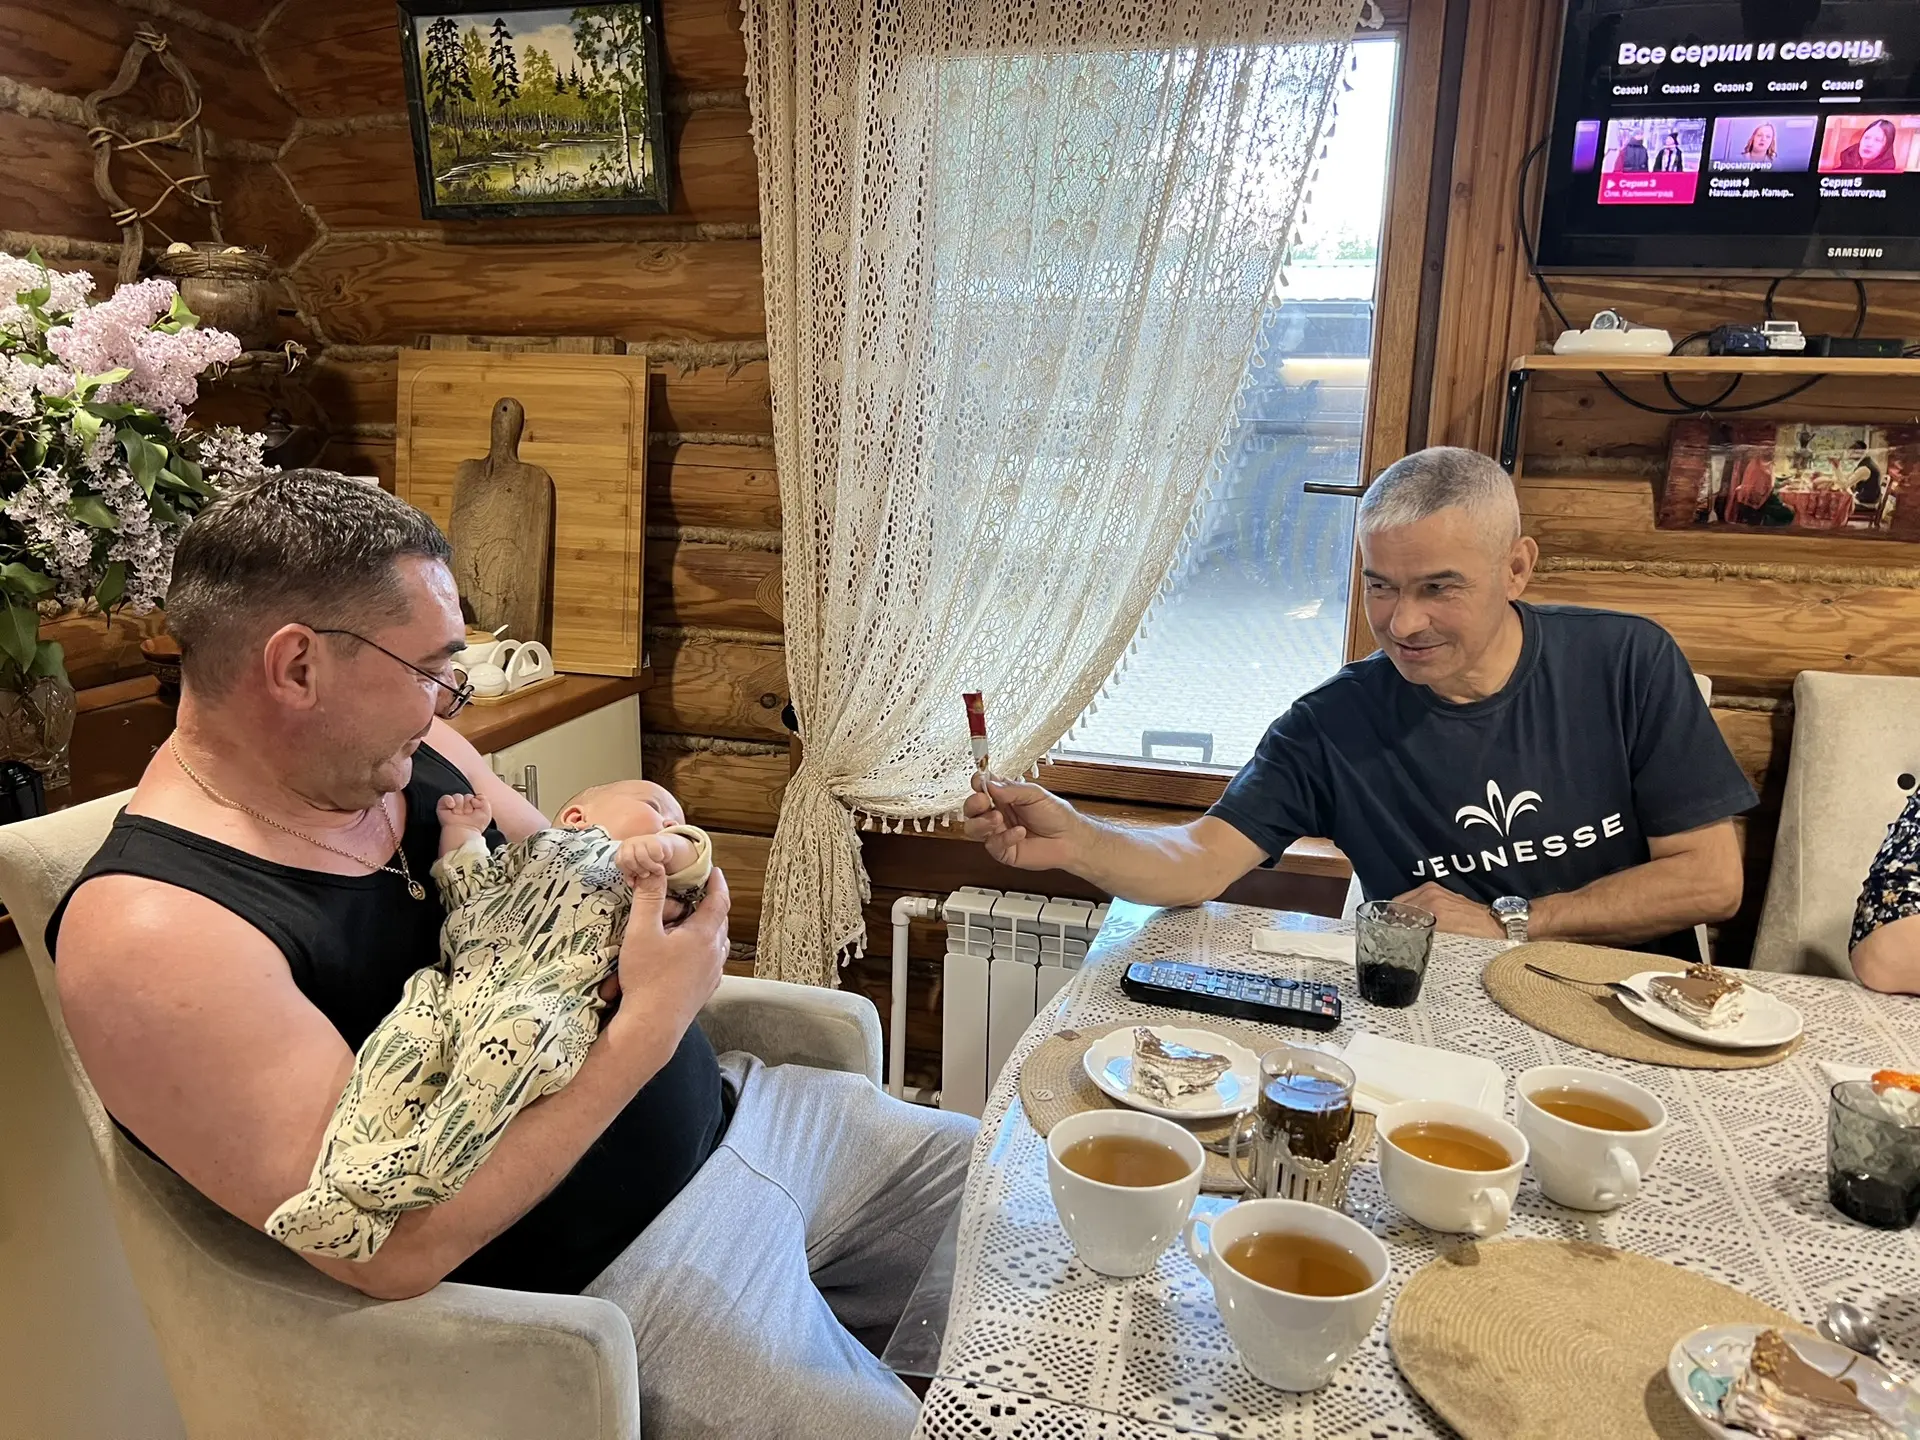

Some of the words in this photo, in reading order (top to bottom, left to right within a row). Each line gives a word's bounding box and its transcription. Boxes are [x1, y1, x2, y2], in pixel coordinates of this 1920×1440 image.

[1617, 42, 1667, 65] Все
[1669, 43, 1753, 67] серии
[1756, 42, 1776, 61] и
[1779, 40, 1883, 60] сезоны
[1612, 84, 1642, 95] Сезон
[1642, 84, 1649, 95] 1
[1661, 83, 1692, 94] Сезон
[1692, 83, 1701, 94] 2
[1713, 82, 1744, 93] Сезон
[1745, 81, 1754, 92] 3
[1767, 81, 1799, 92] Сезон
[1799, 81, 1808, 91] 4
[1821, 80, 1853, 91] Сезон
[1853, 79, 1864, 91] 5
[1713, 161, 1772, 171] Просмотрено
[1619, 179, 1649, 189] Серия
[1710, 177, 1741, 189] Серия
[1742, 177, 1750, 187] 4
[1820, 177, 1853, 189] Серия
[1853, 177, 1863, 187] 5
[1841, 188, 1887, 198] Волгоград
[1827, 247, 1883, 258] SAMSUNG
[1412, 812, 1625, 878] JEUNESSE
